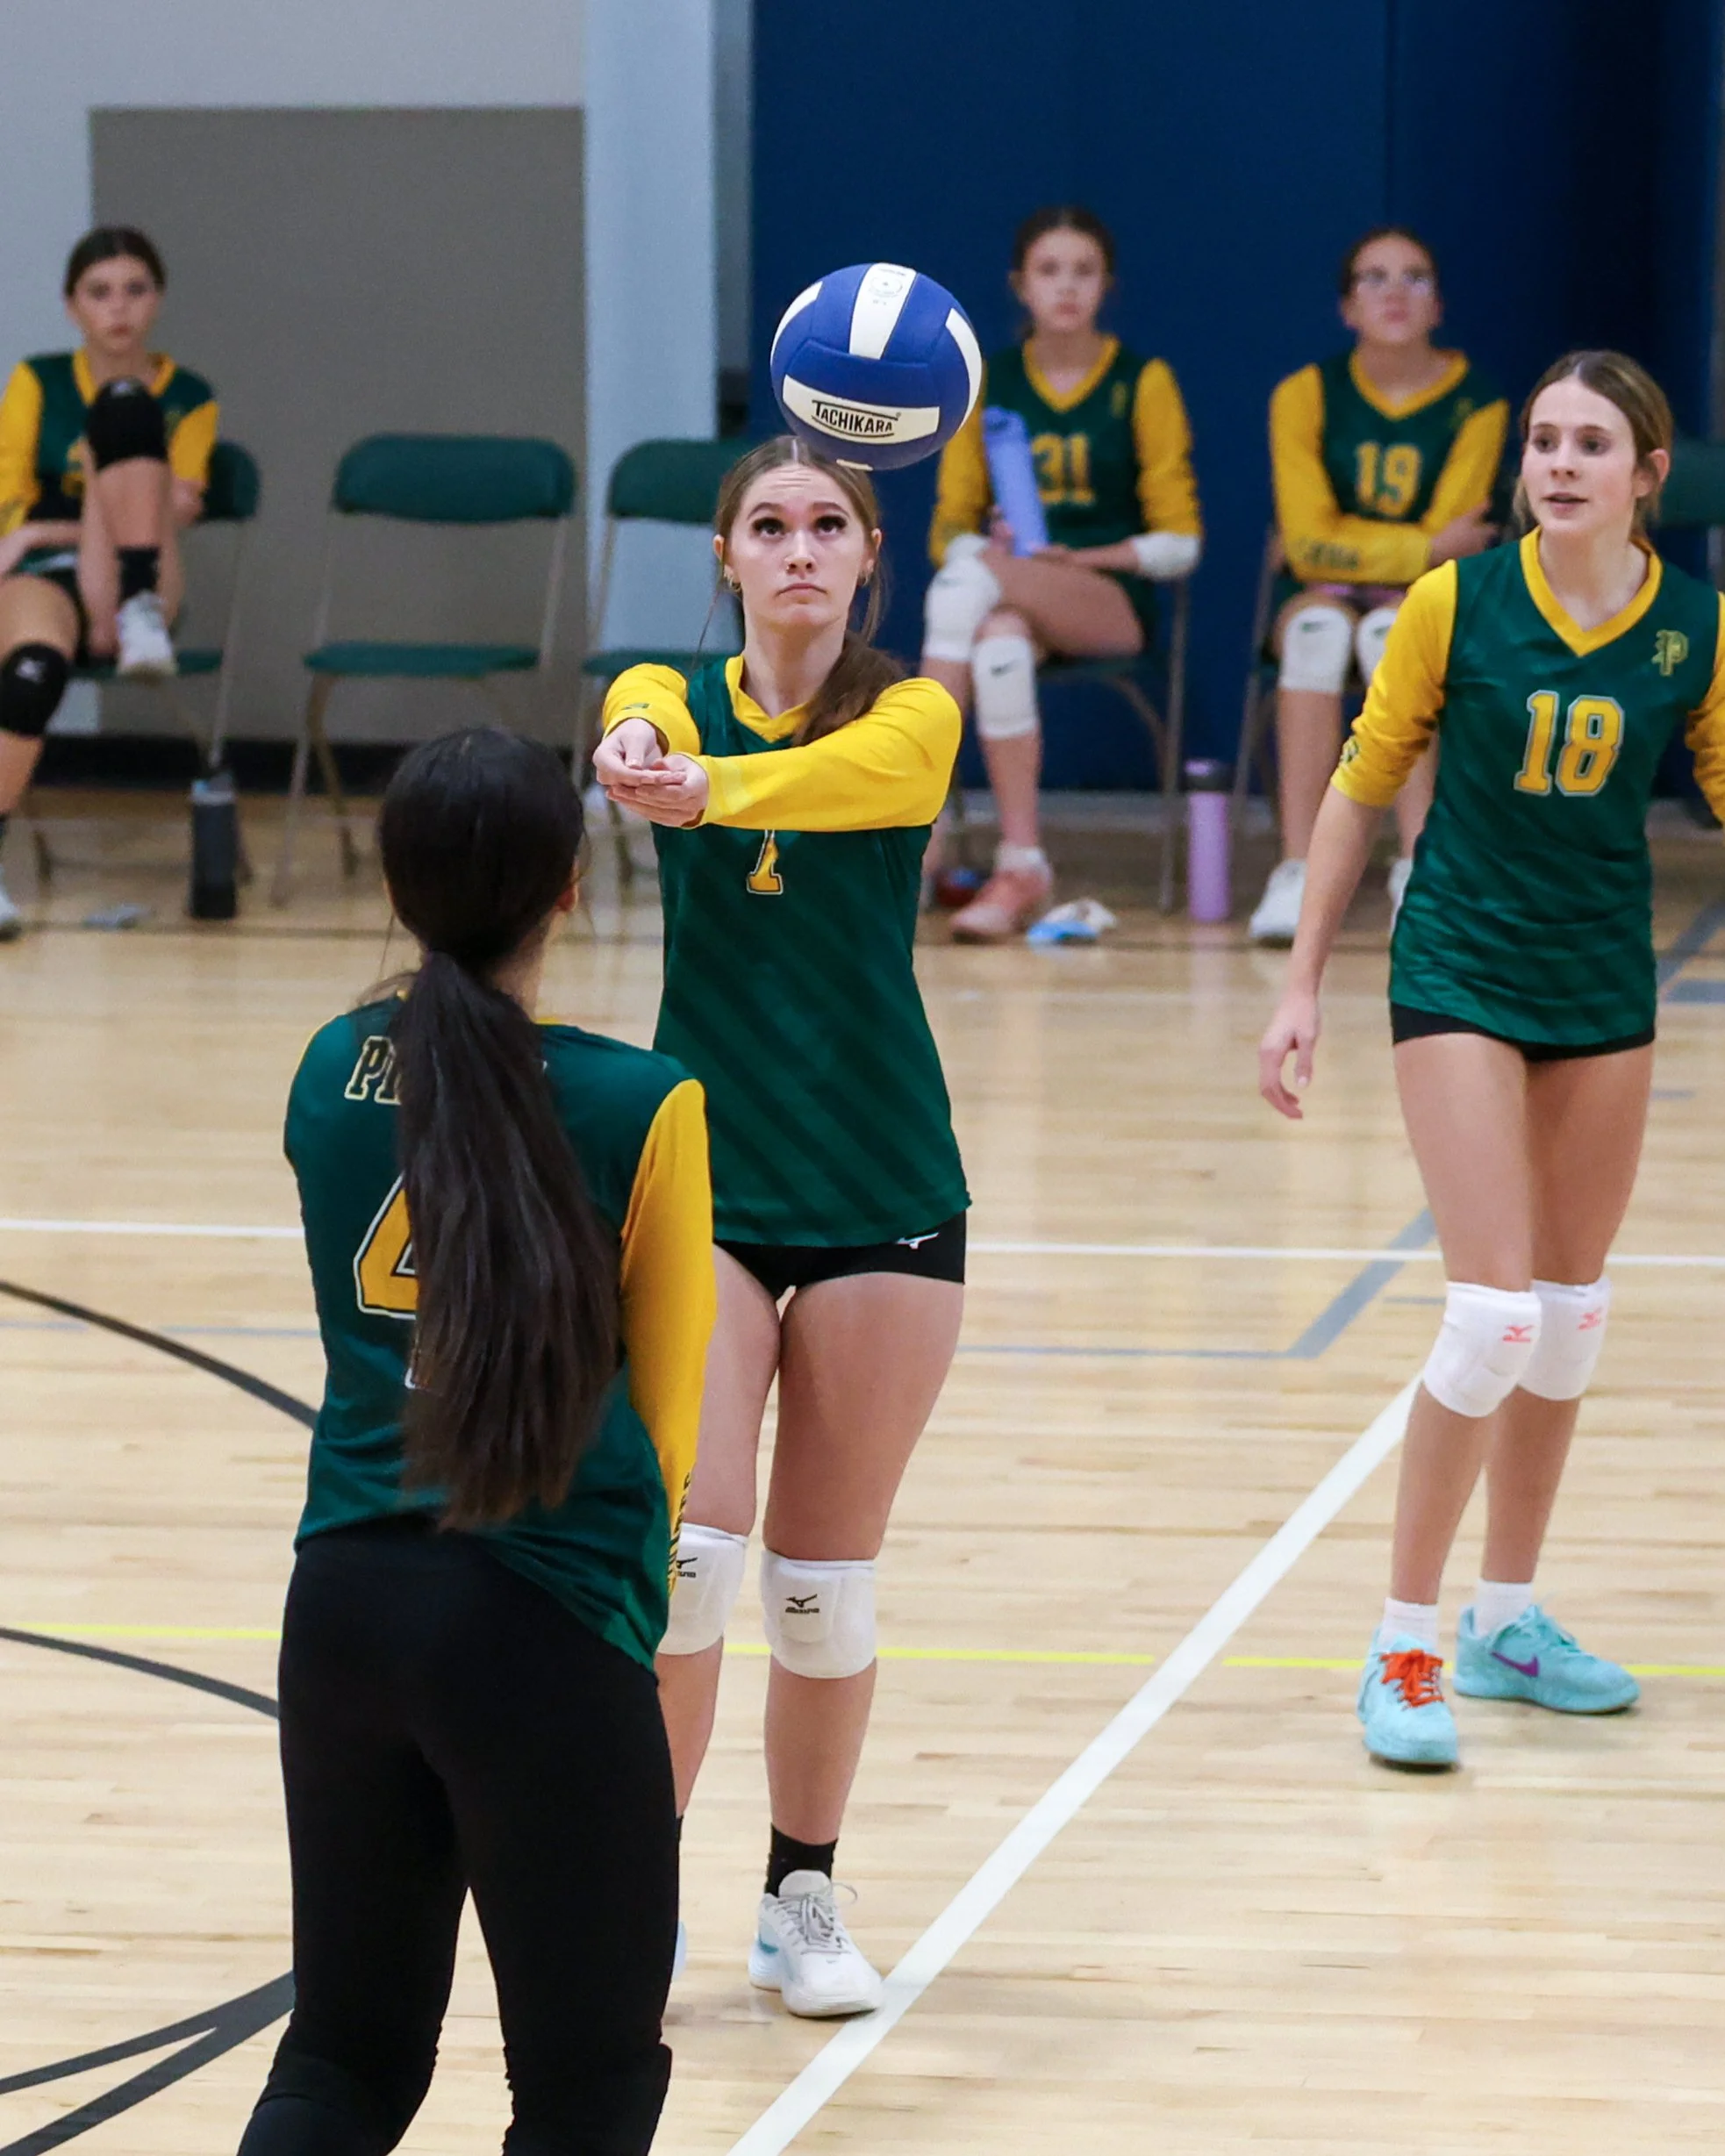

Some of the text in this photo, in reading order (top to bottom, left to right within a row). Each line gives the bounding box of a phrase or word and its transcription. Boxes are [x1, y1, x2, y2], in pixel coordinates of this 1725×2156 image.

[812, 400, 898, 433] TACHIKARA
[1031, 432, 1097, 505] 31
[1354, 440, 1422, 518] 19
[1514, 689, 1625, 797] 18
